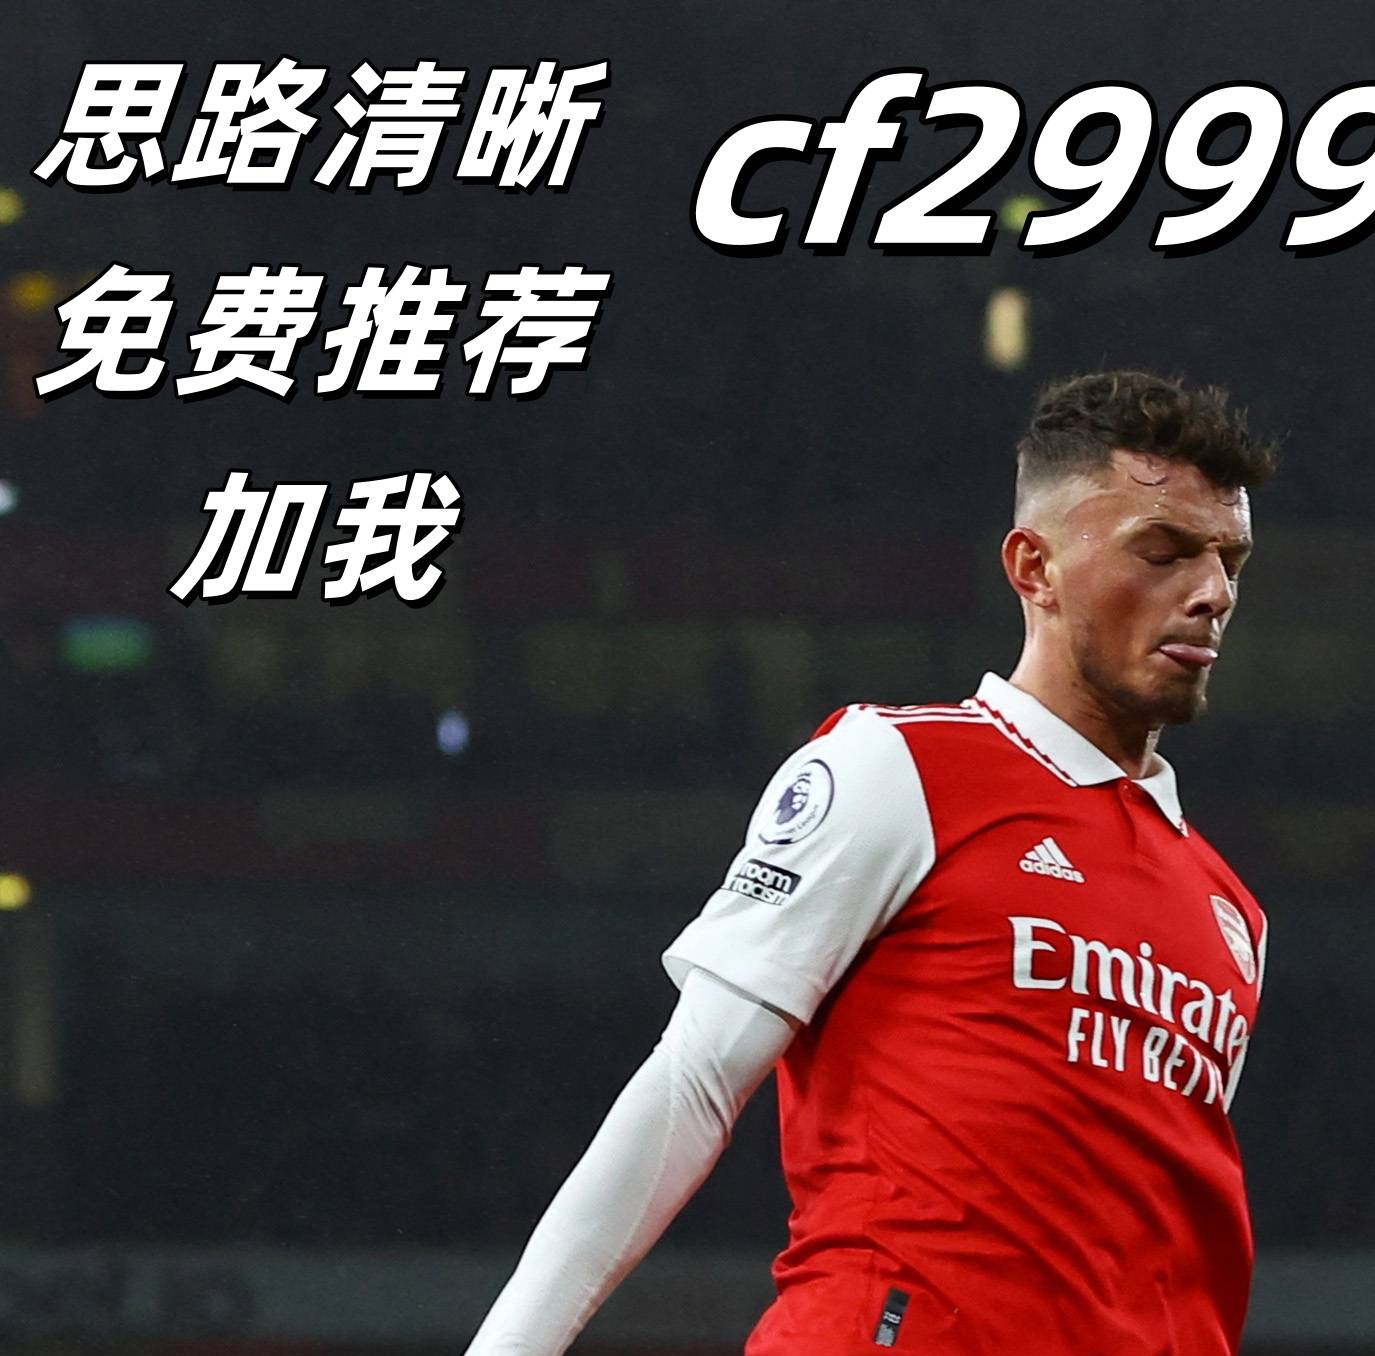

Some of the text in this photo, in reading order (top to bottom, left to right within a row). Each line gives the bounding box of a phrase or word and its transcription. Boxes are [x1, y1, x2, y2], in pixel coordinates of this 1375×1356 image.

[1019, 859, 1086, 884] adidas
[1007, 916, 1250, 1067] Emirate
[1066, 1007, 1132, 1073] FLY
